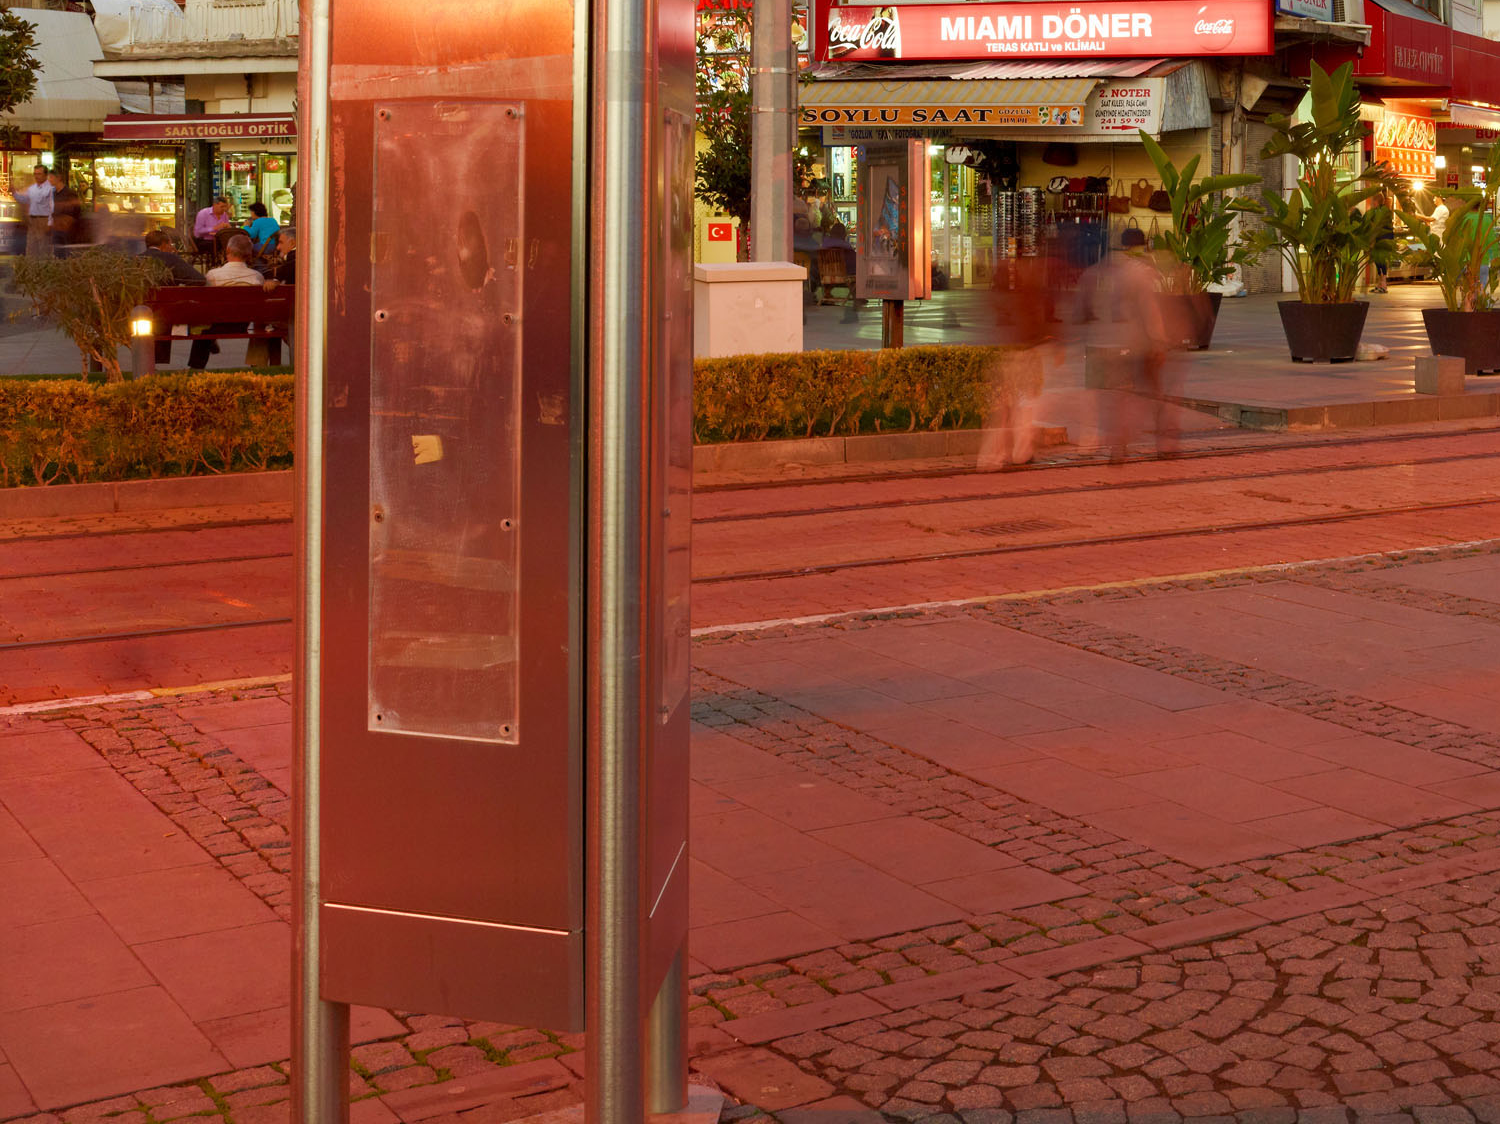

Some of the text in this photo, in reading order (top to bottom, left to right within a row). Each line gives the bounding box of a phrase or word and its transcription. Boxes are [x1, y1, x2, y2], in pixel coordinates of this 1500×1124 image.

[940, 8, 1153, 41] MIAMI DÖNER
[986, 39, 1106, 53] TERAS KATLI ve KLİMALI
[1099, 88, 1152, 98] 2. NOTER
[802, 109, 992, 124] SOYLU SAAT
[165, 122, 288, 138] SAATÇİOĞLU OPTİK
